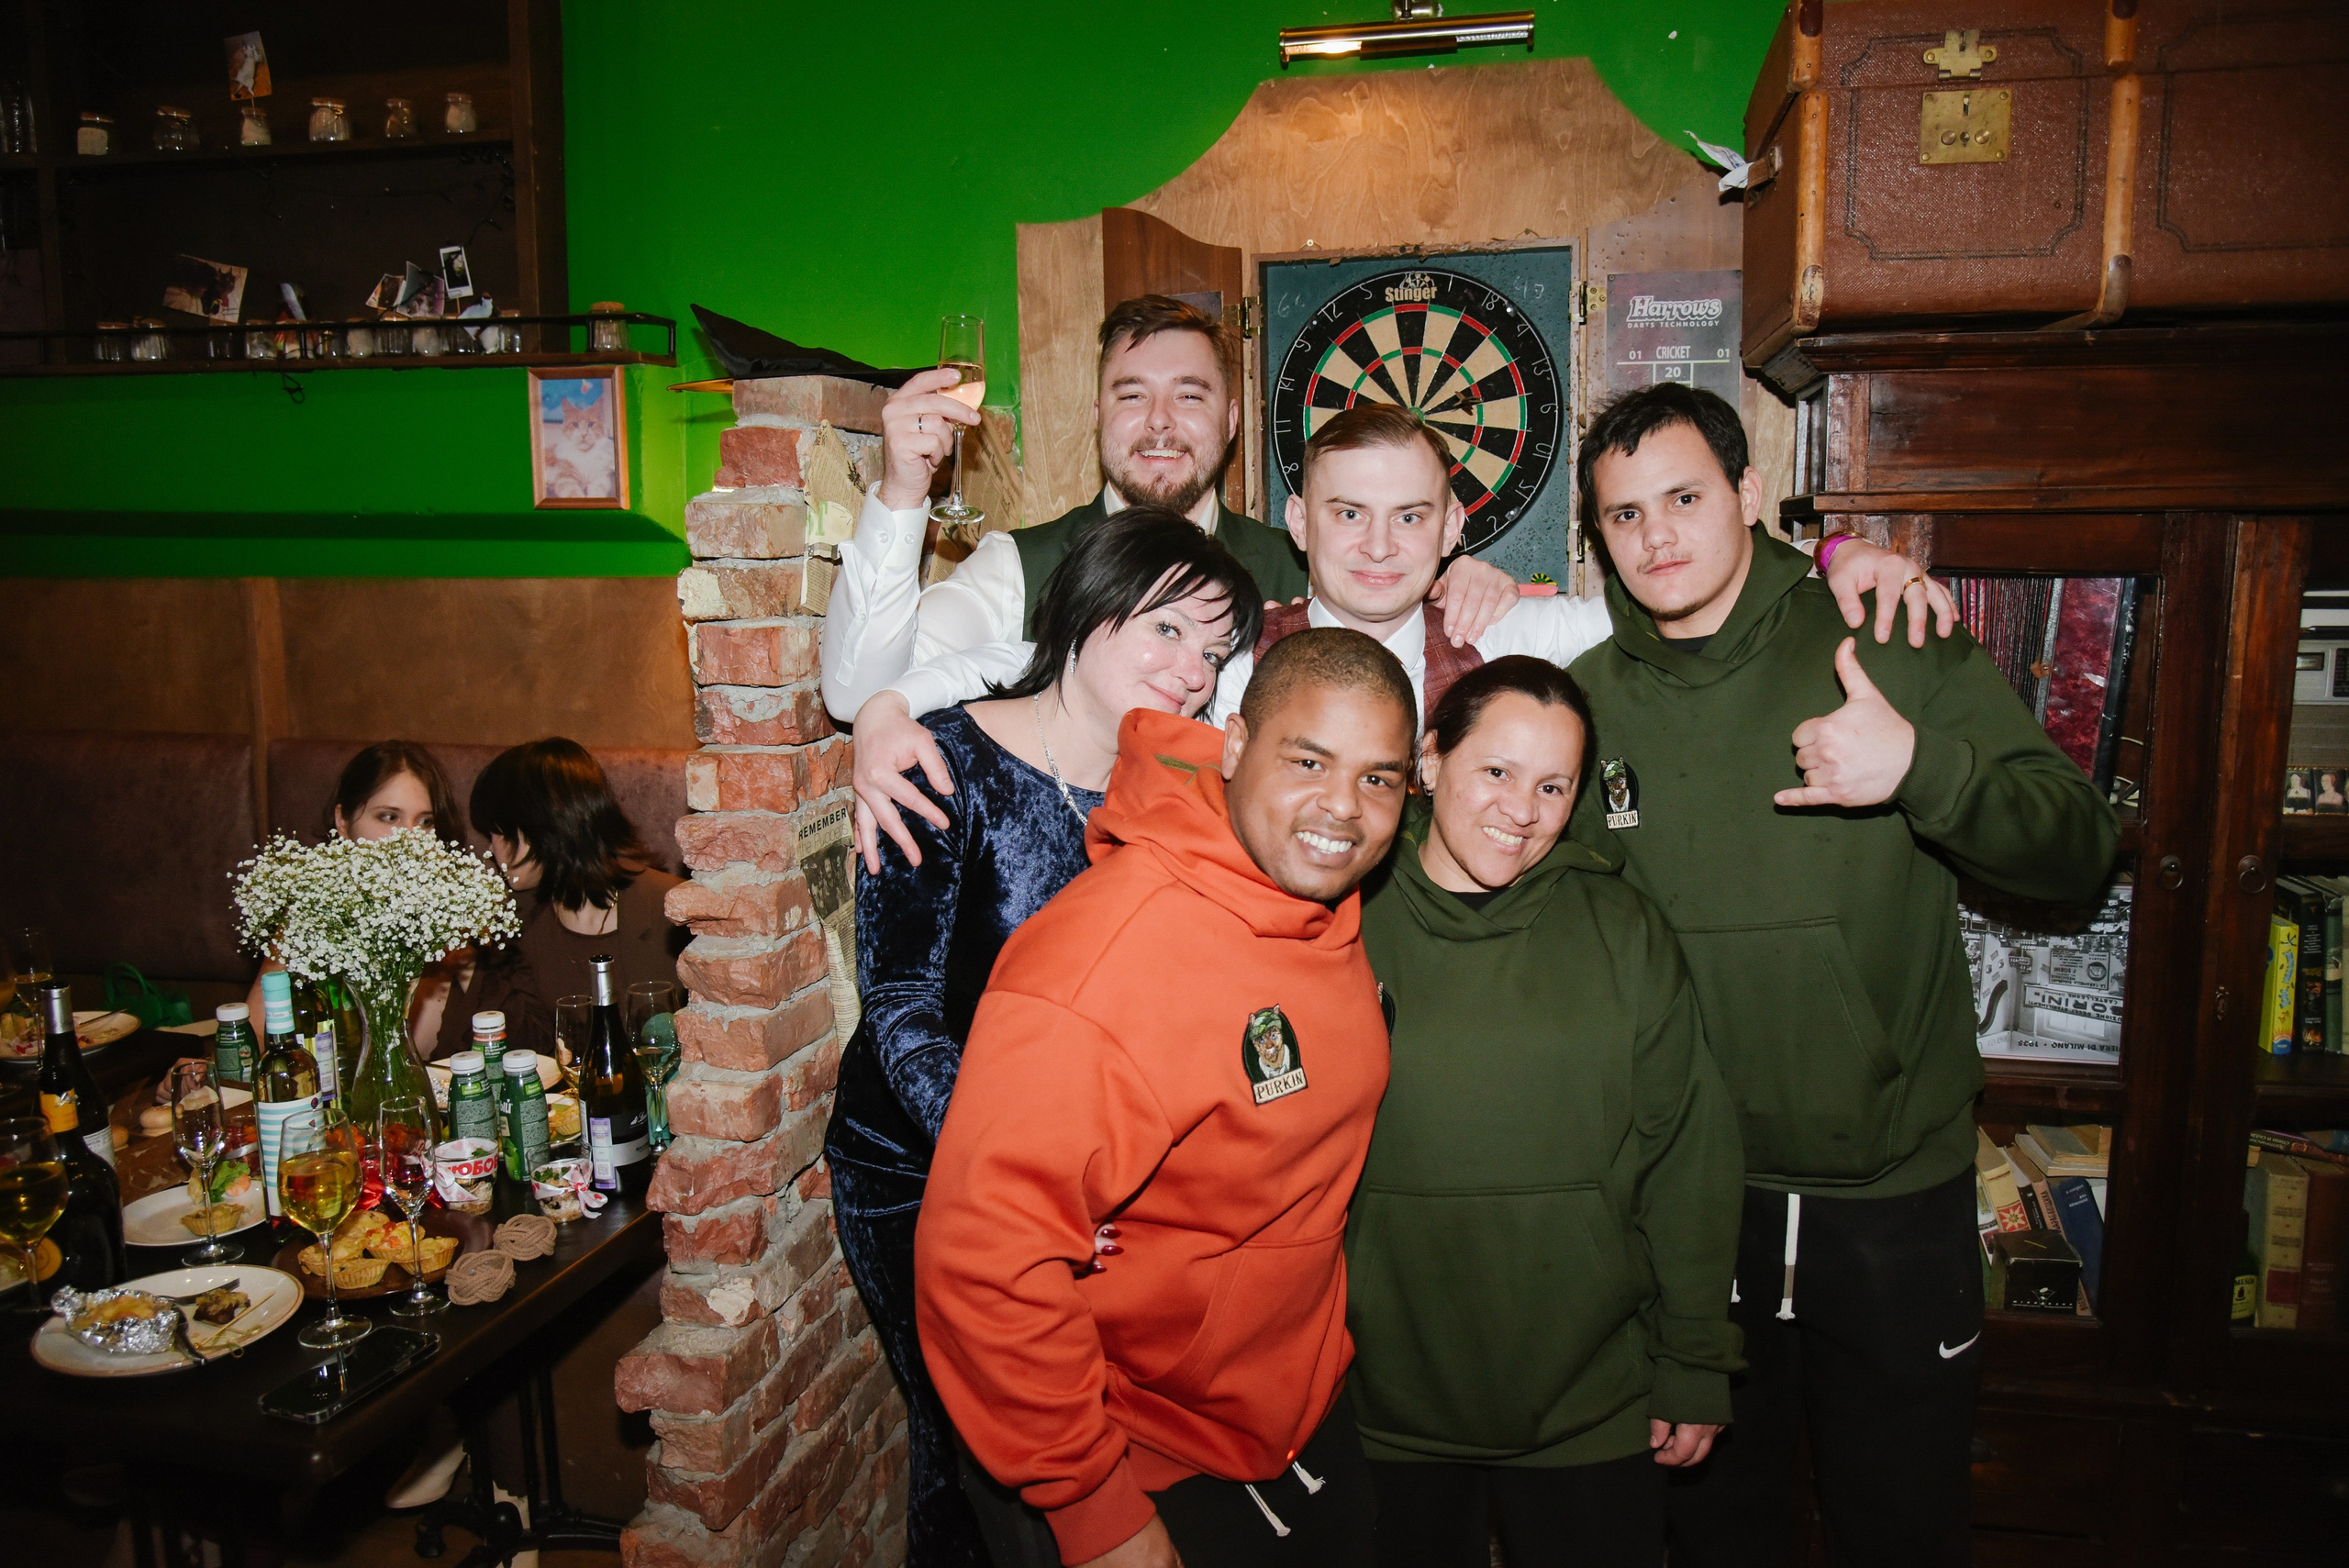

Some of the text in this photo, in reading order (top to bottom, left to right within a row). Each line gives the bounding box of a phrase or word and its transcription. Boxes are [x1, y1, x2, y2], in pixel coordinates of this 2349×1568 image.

[1359, 284, 1373, 300] 5
[1385, 286, 1438, 303] Stinger
[1481, 289, 1500, 311] 18
[1318, 302, 1343, 323] 12
[1627, 296, 1722, 322] Harrows
[1516, 322, 1532, 337] 4
[1295, 340, 1312, 353] 9
[1629, 346, 1731, 360] 01 CRICKET 01
[1531, 357, 1551, 376] 13
[1664, 367, 1681, 378] 20
[1539, 402, 1558, 415] 6
[1274, 418, 1292, 434] 11
[1531, 442, 1553, 460] 10
[1282, 462, 1299, 474] 8
[1514, 481, 1535, 500] 15
[1486, 516, 1503, 533] 2
[798, 807, 847, 841] REMEMBER
[1608, 812, 1637, 827] PURKIN
[2066, 993, 2118, 1005] CASTELLEONE
[2096, 1013, 2121, 1022] UZIONE
[2017, 1040, 2039, 1048] 1935
[2051, 1041, 2085, 1050] MILANO
[1256, 1071, 1304, 1100] PURKIN
